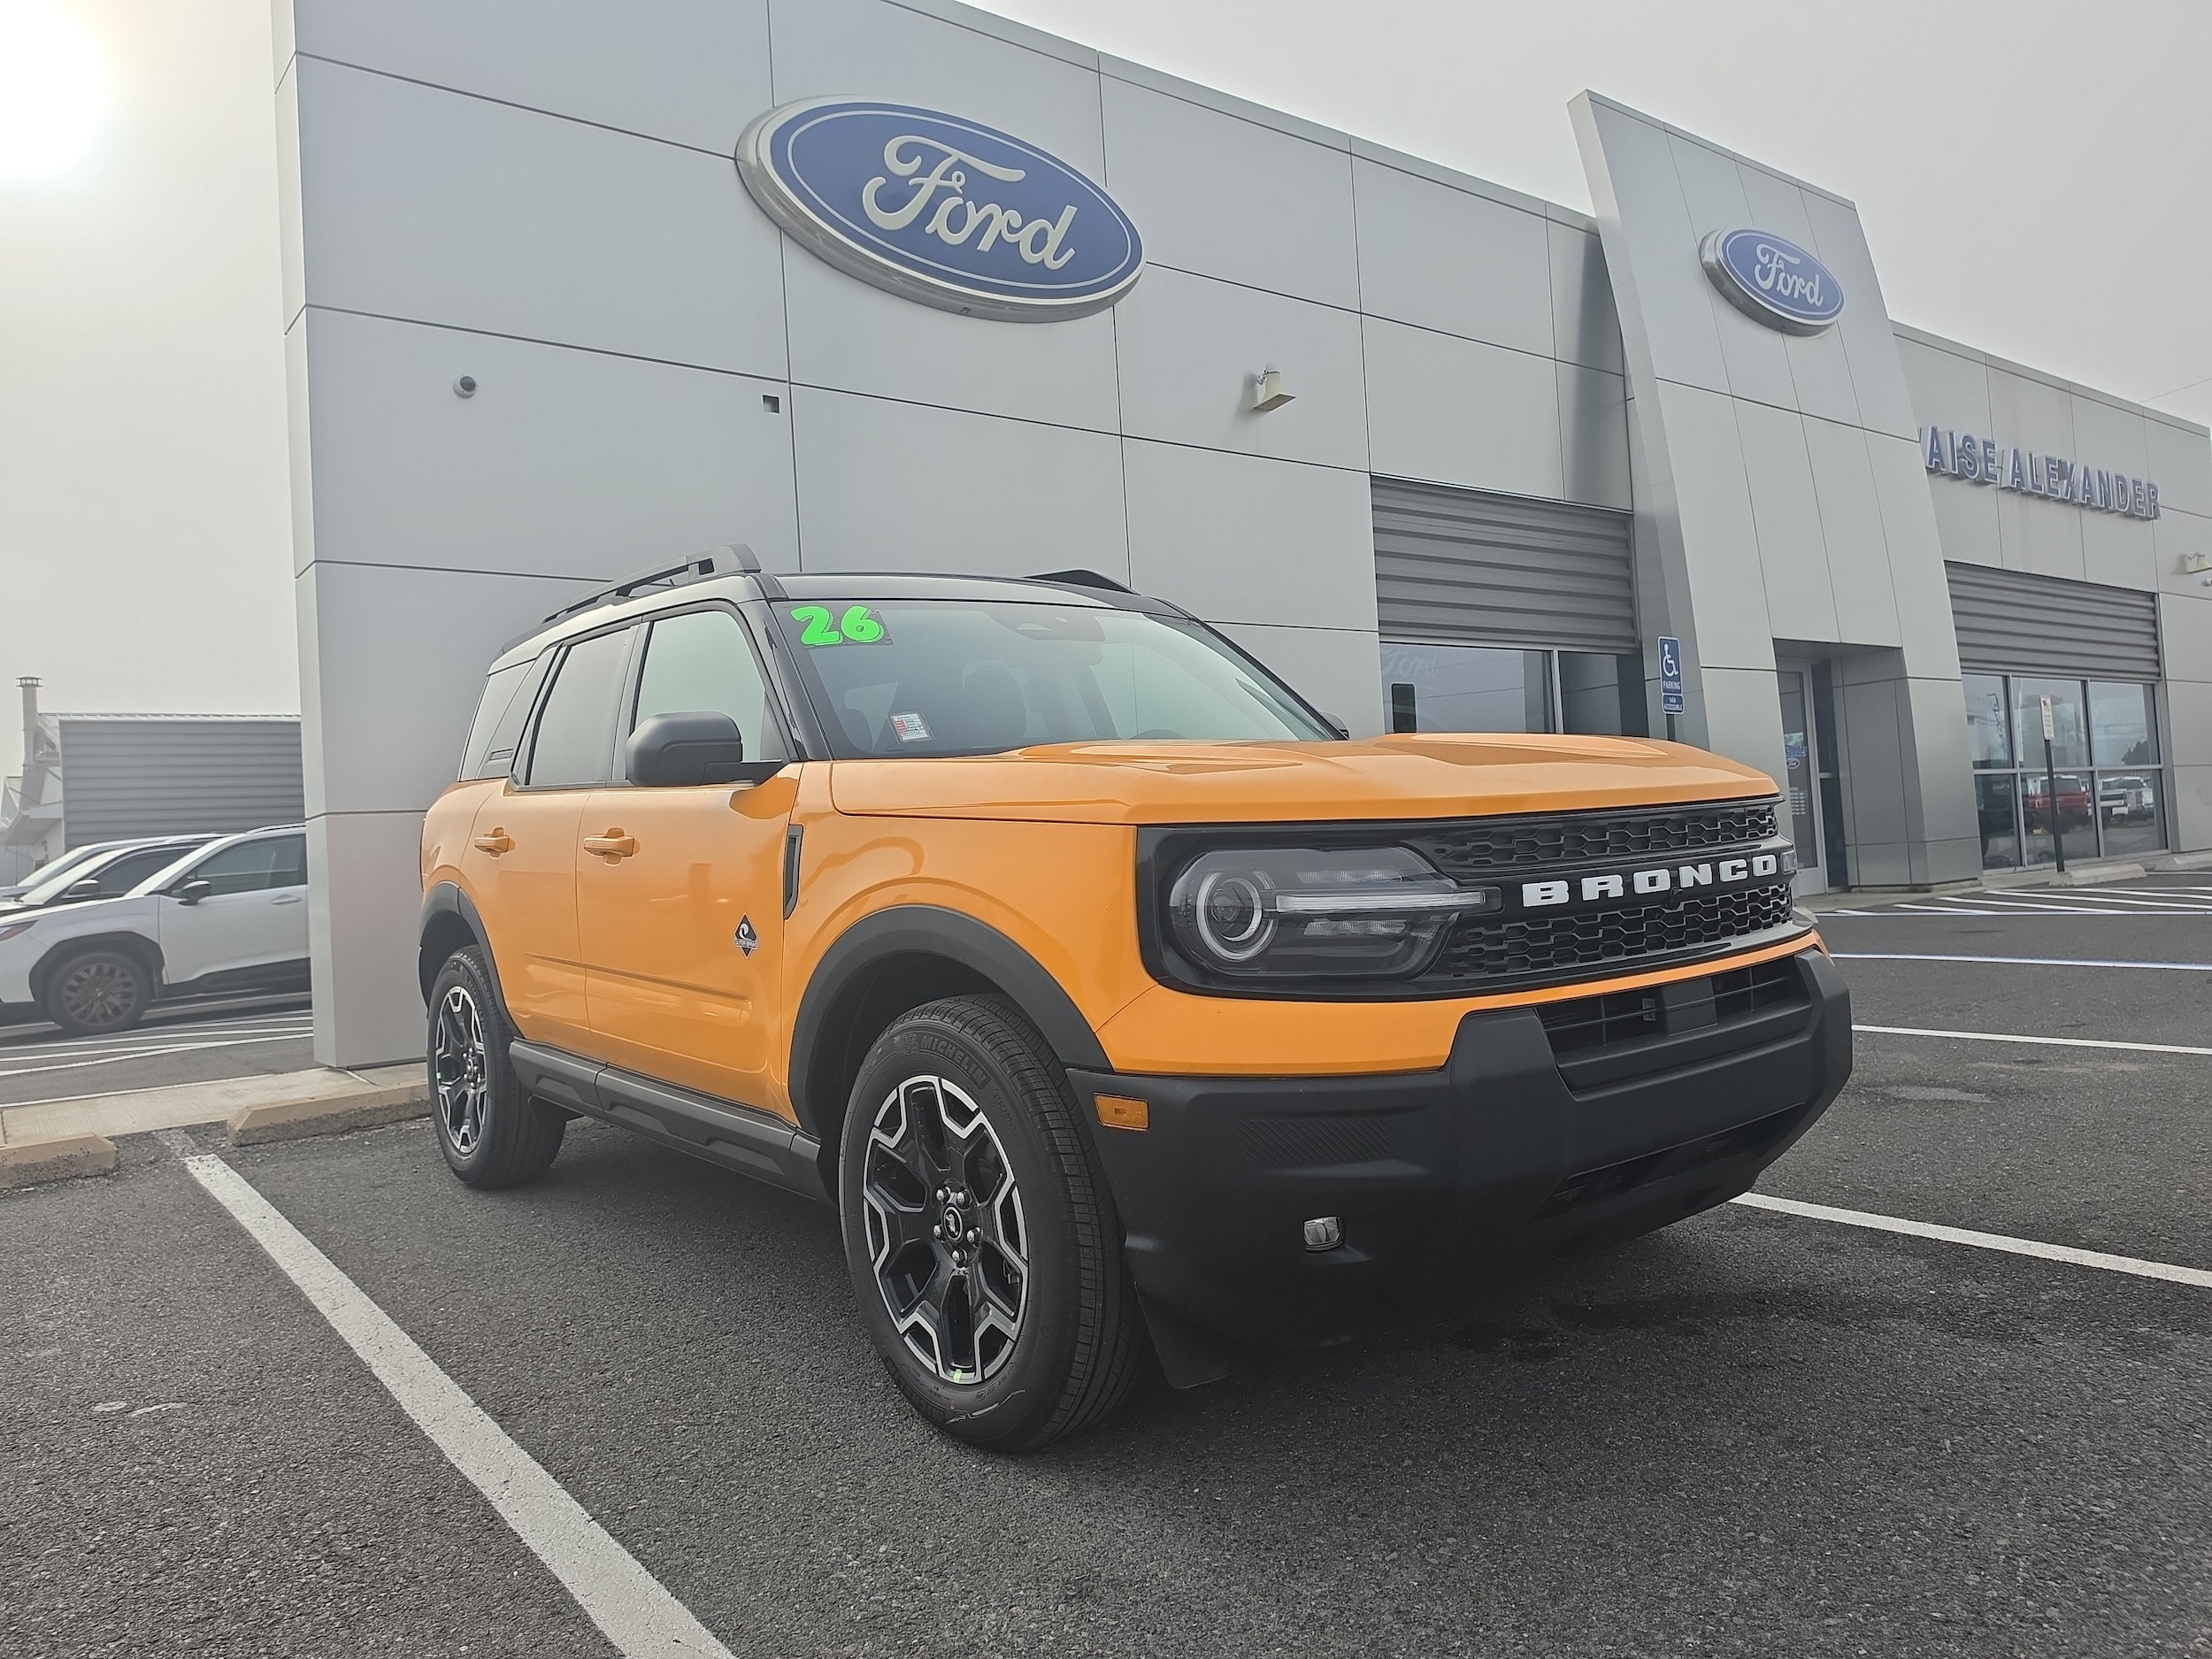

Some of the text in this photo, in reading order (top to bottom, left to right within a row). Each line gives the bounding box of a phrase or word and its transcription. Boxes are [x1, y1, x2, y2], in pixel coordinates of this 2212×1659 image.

[862, 135, 1078, 270] Ford
[1755, 243, 1824, 307] Ford
[2007, 447, 2161, 519] ALEXANDER
[791, 606, 884, 646] 26
[1663, 680, 1680, 690] PARKING
[1522, 854, 1777, 908] BRONCO
[920, 1035, 987, 1085] MICHELIN
